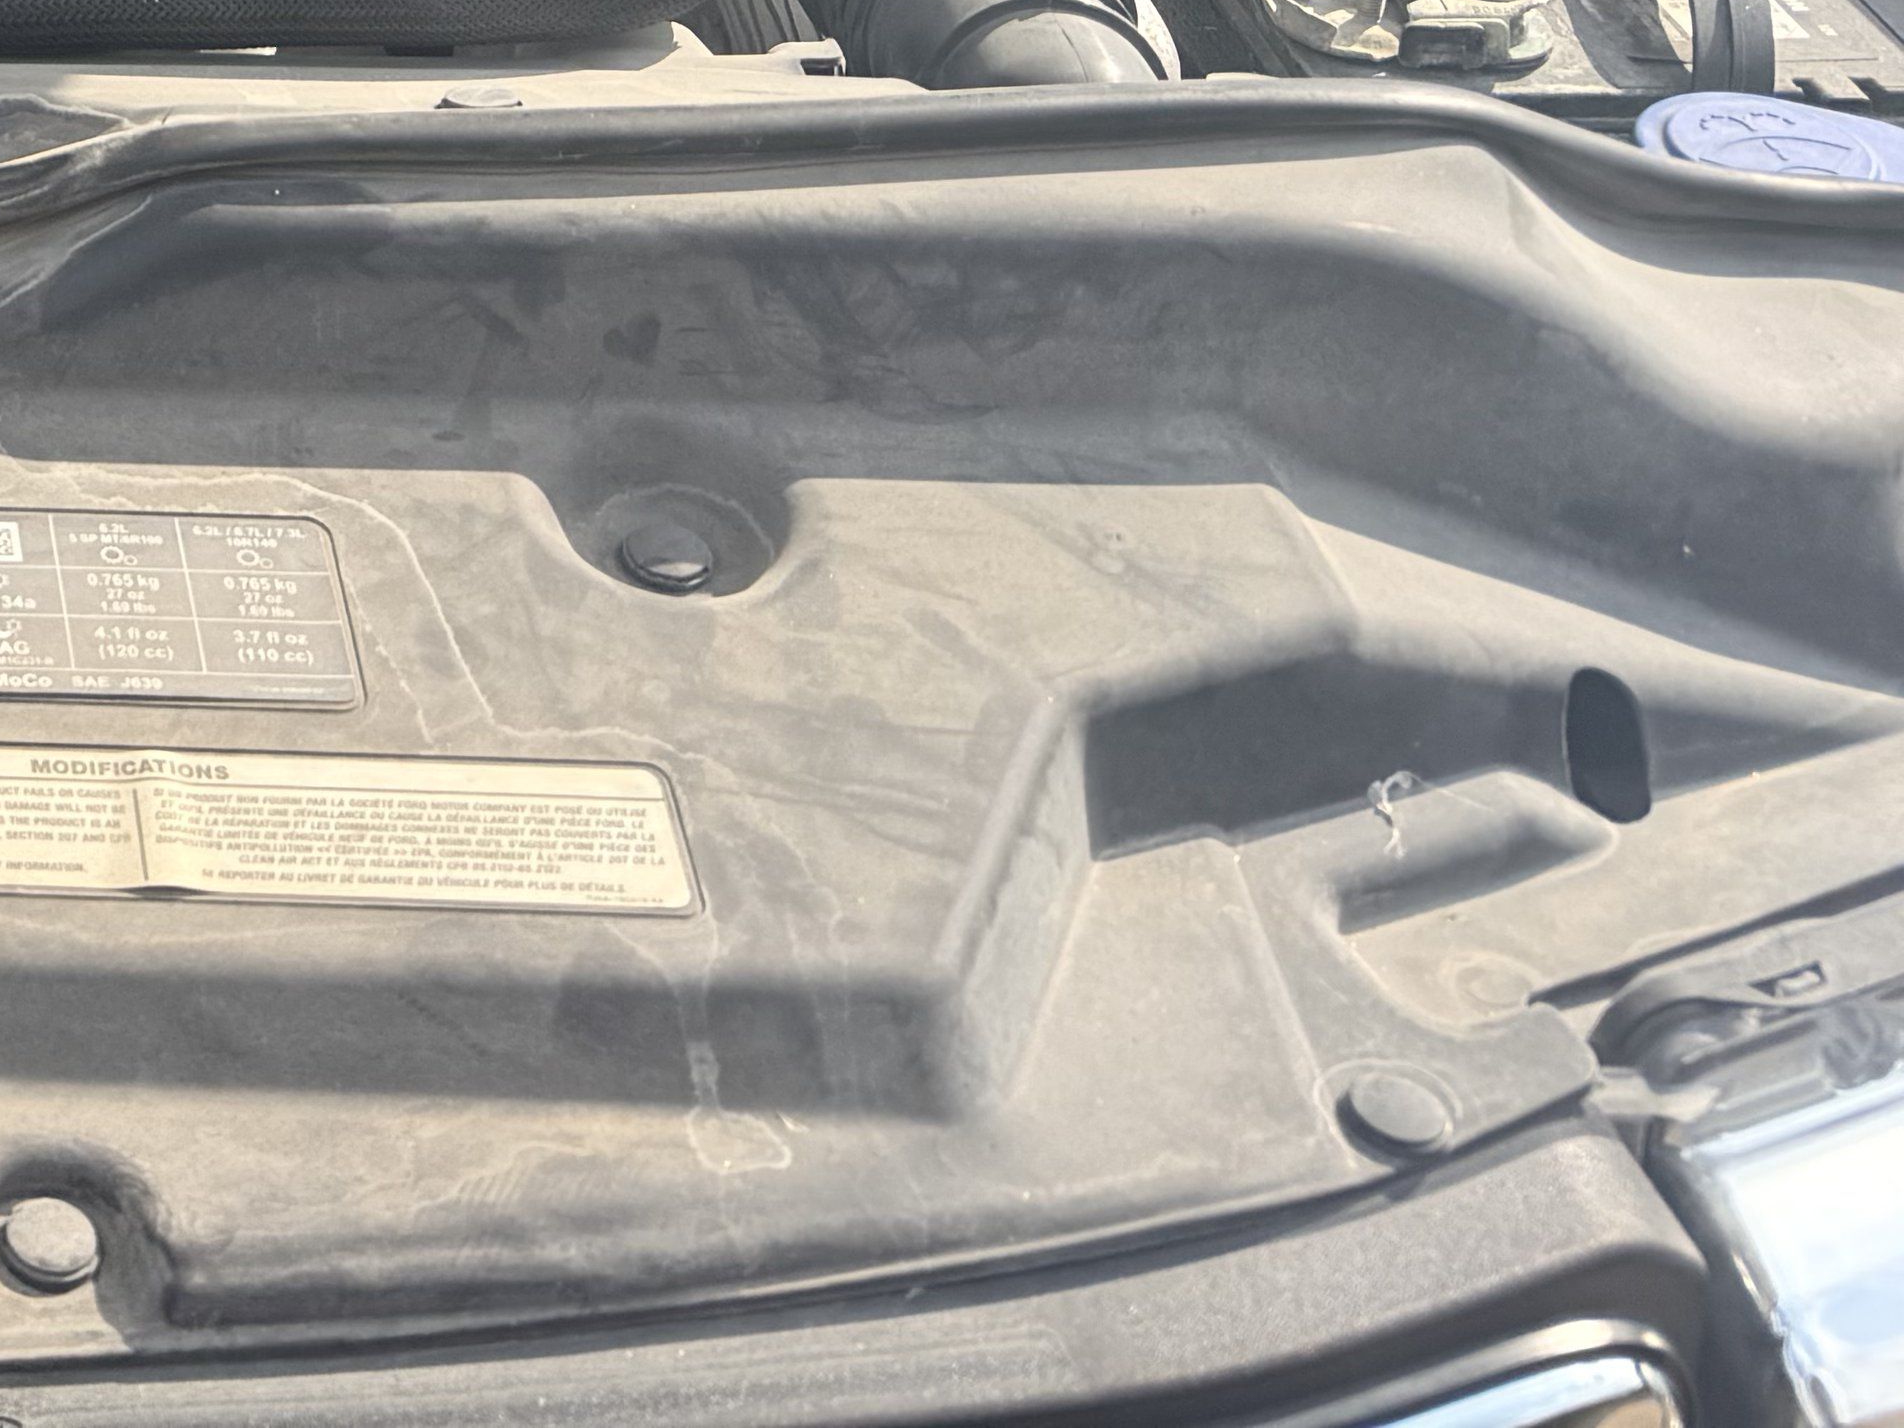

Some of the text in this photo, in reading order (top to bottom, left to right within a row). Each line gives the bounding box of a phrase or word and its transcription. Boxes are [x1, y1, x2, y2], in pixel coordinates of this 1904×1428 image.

[87, 574, 160, 591] 0.765 kg
[224, 576, 297, 594] 0.765 kg
[107, 588, 145, 600] 27 oz
[244, 592, 283, 603] 27 oz
[94, 626, 123, 640] 4.1
[145, 630, 168, 640] oz
[233, 629, 260, 643] 3.7
[284, 634, 308, 645] oz
[98, 643, 174, 661] (120 cc)
[238, 647, 314, 666] (110 cc)
[71, 676, 110, 688] SAE
[30, 757, 230, 780] MODIFICATIONS
